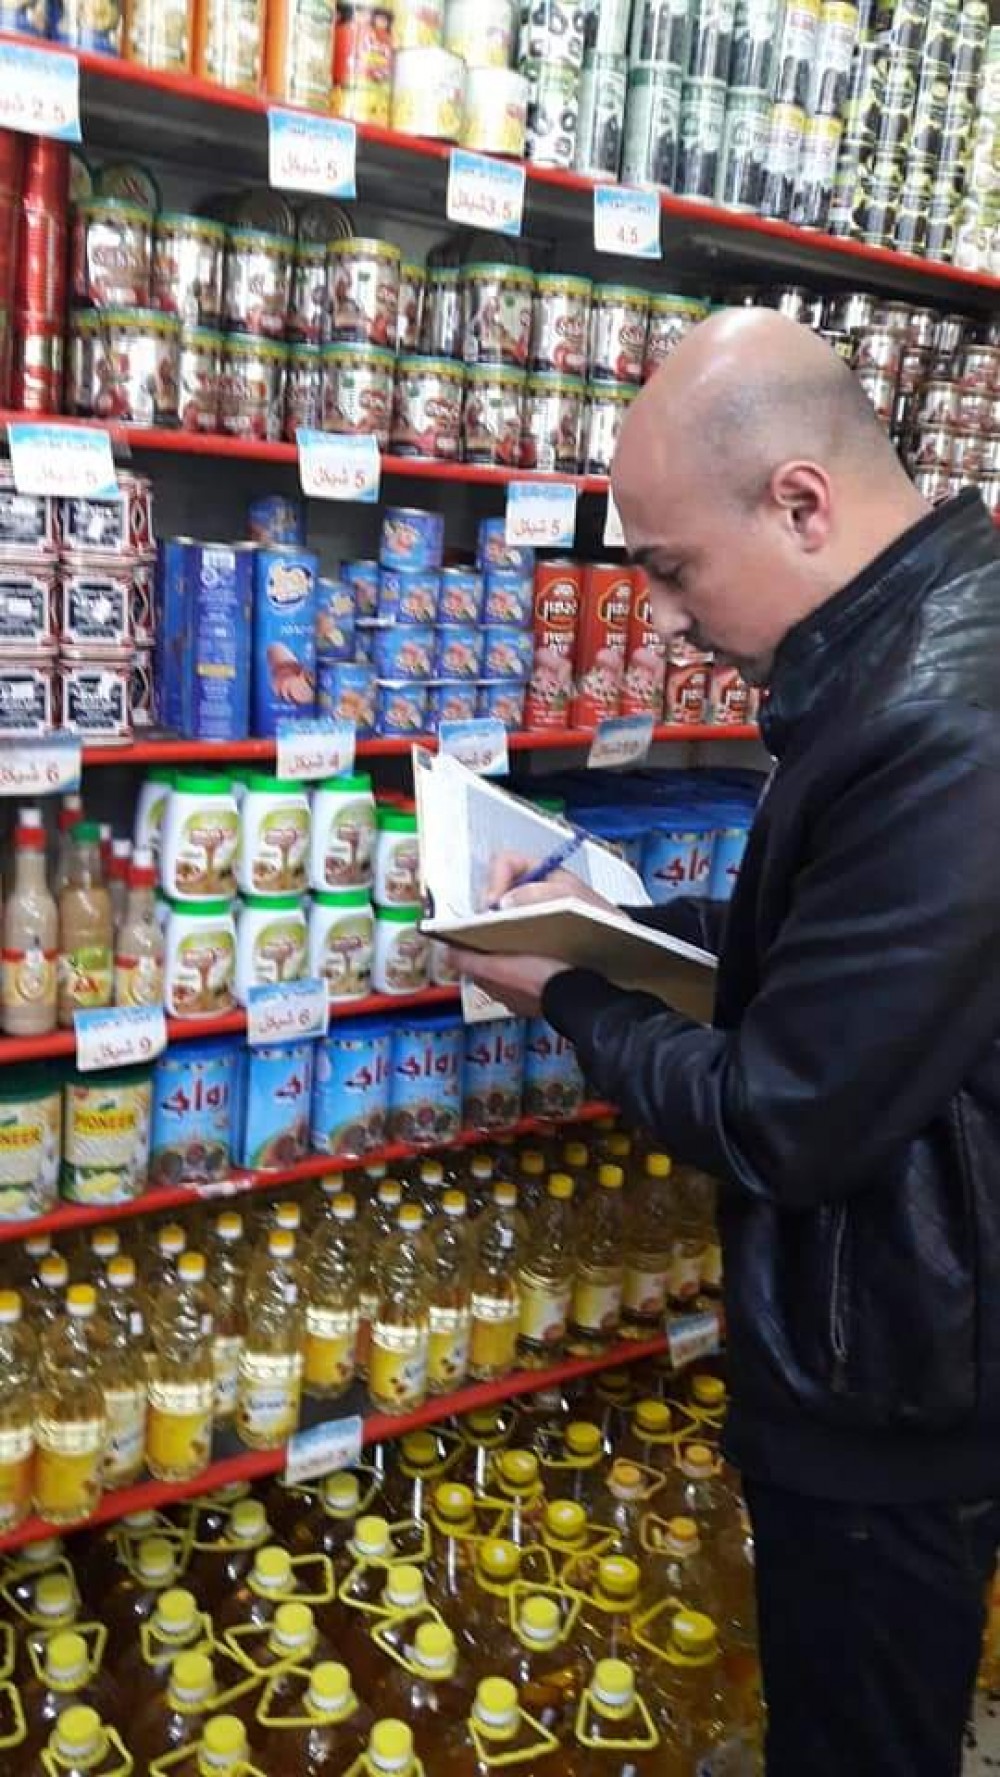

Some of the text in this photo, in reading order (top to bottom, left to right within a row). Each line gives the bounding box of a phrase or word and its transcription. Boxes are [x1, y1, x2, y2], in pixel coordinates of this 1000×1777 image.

[327, 160, 338, 180] 5
[354, 470, 366, 489] 5
[551, 518, 561, 536] 5
[139, 1037, 151, 1055] 9
